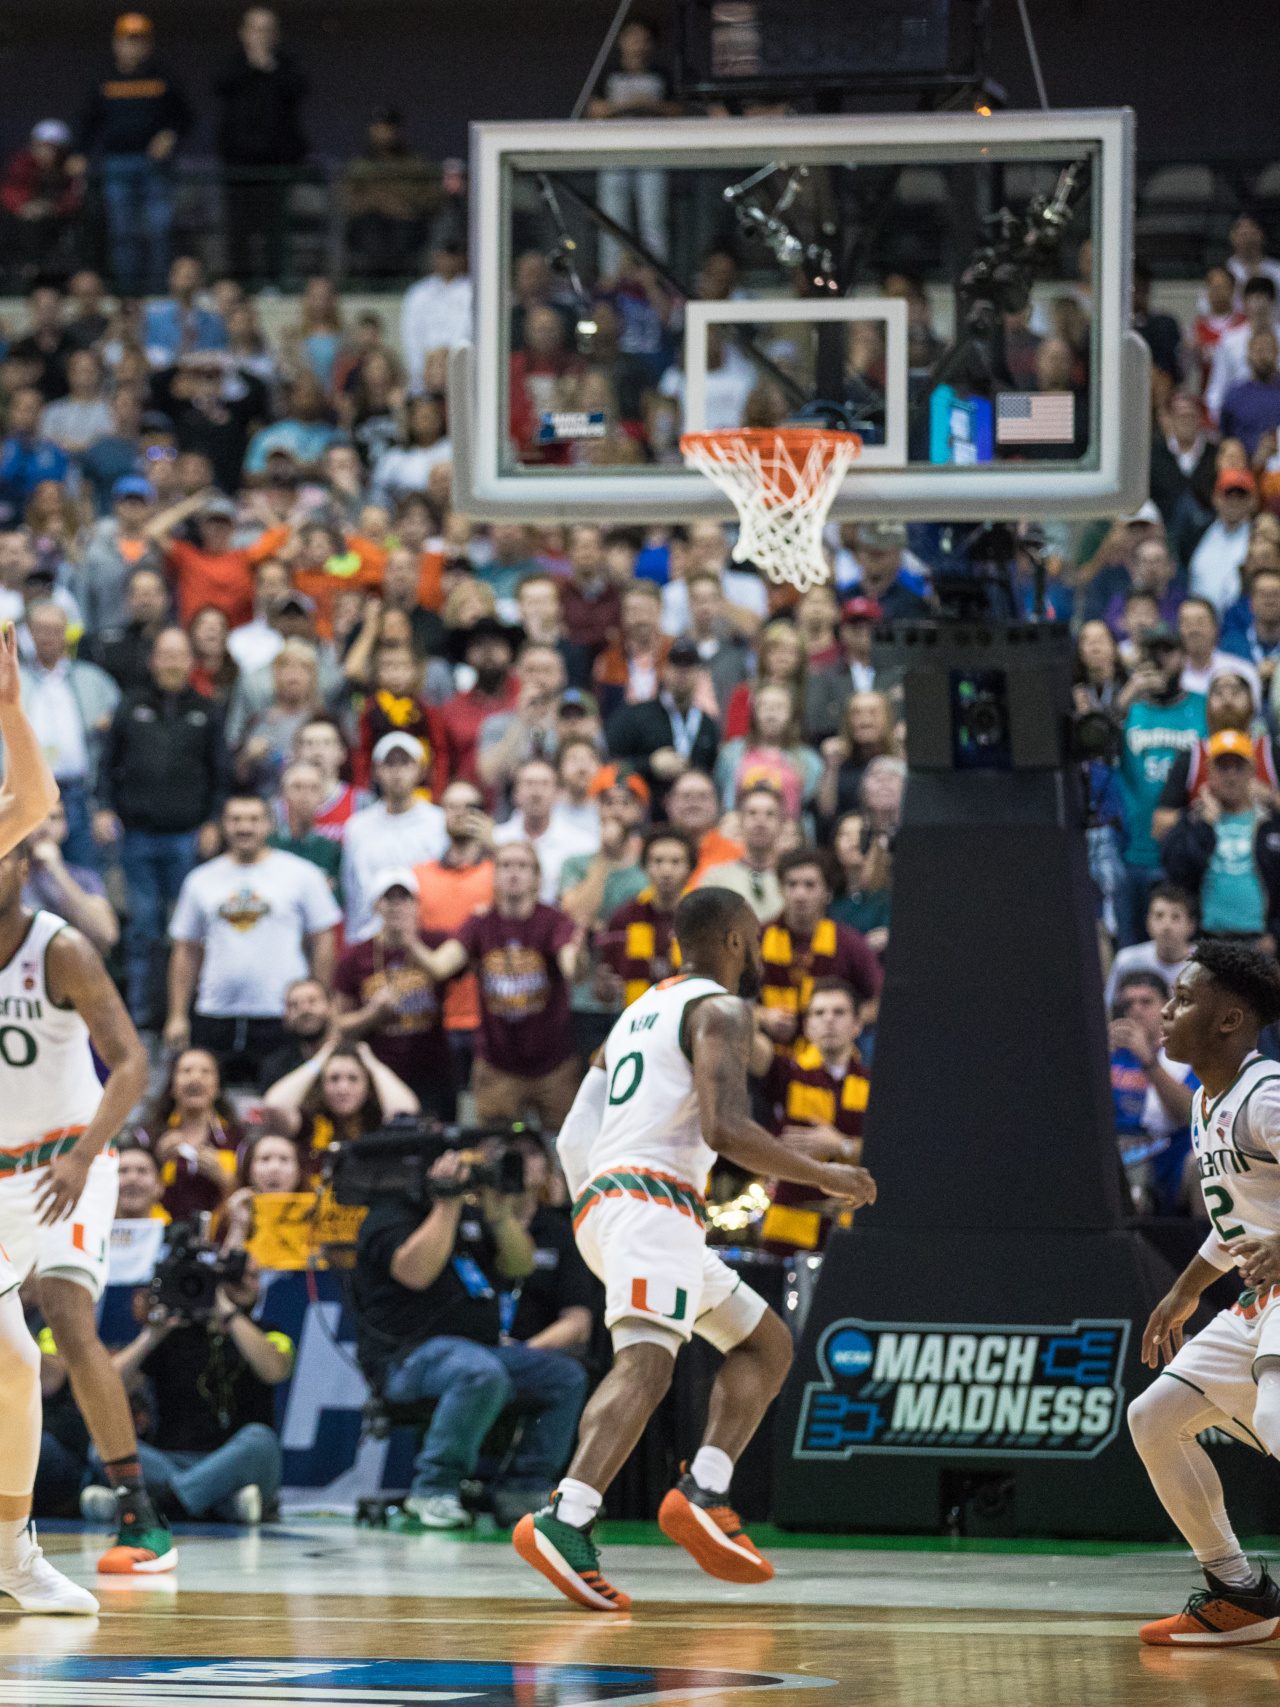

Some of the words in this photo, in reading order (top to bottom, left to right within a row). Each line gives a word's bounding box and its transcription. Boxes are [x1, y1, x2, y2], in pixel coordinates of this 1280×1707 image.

[609, 1051, 644, 1105] 0
[1204, 1185, 1246, 1242] 2
[630, 1277, 687, 1320] U
[872, 1333, 1039, 1383] MARCH
[890, 1384, 1116, 1435] MADNESS
